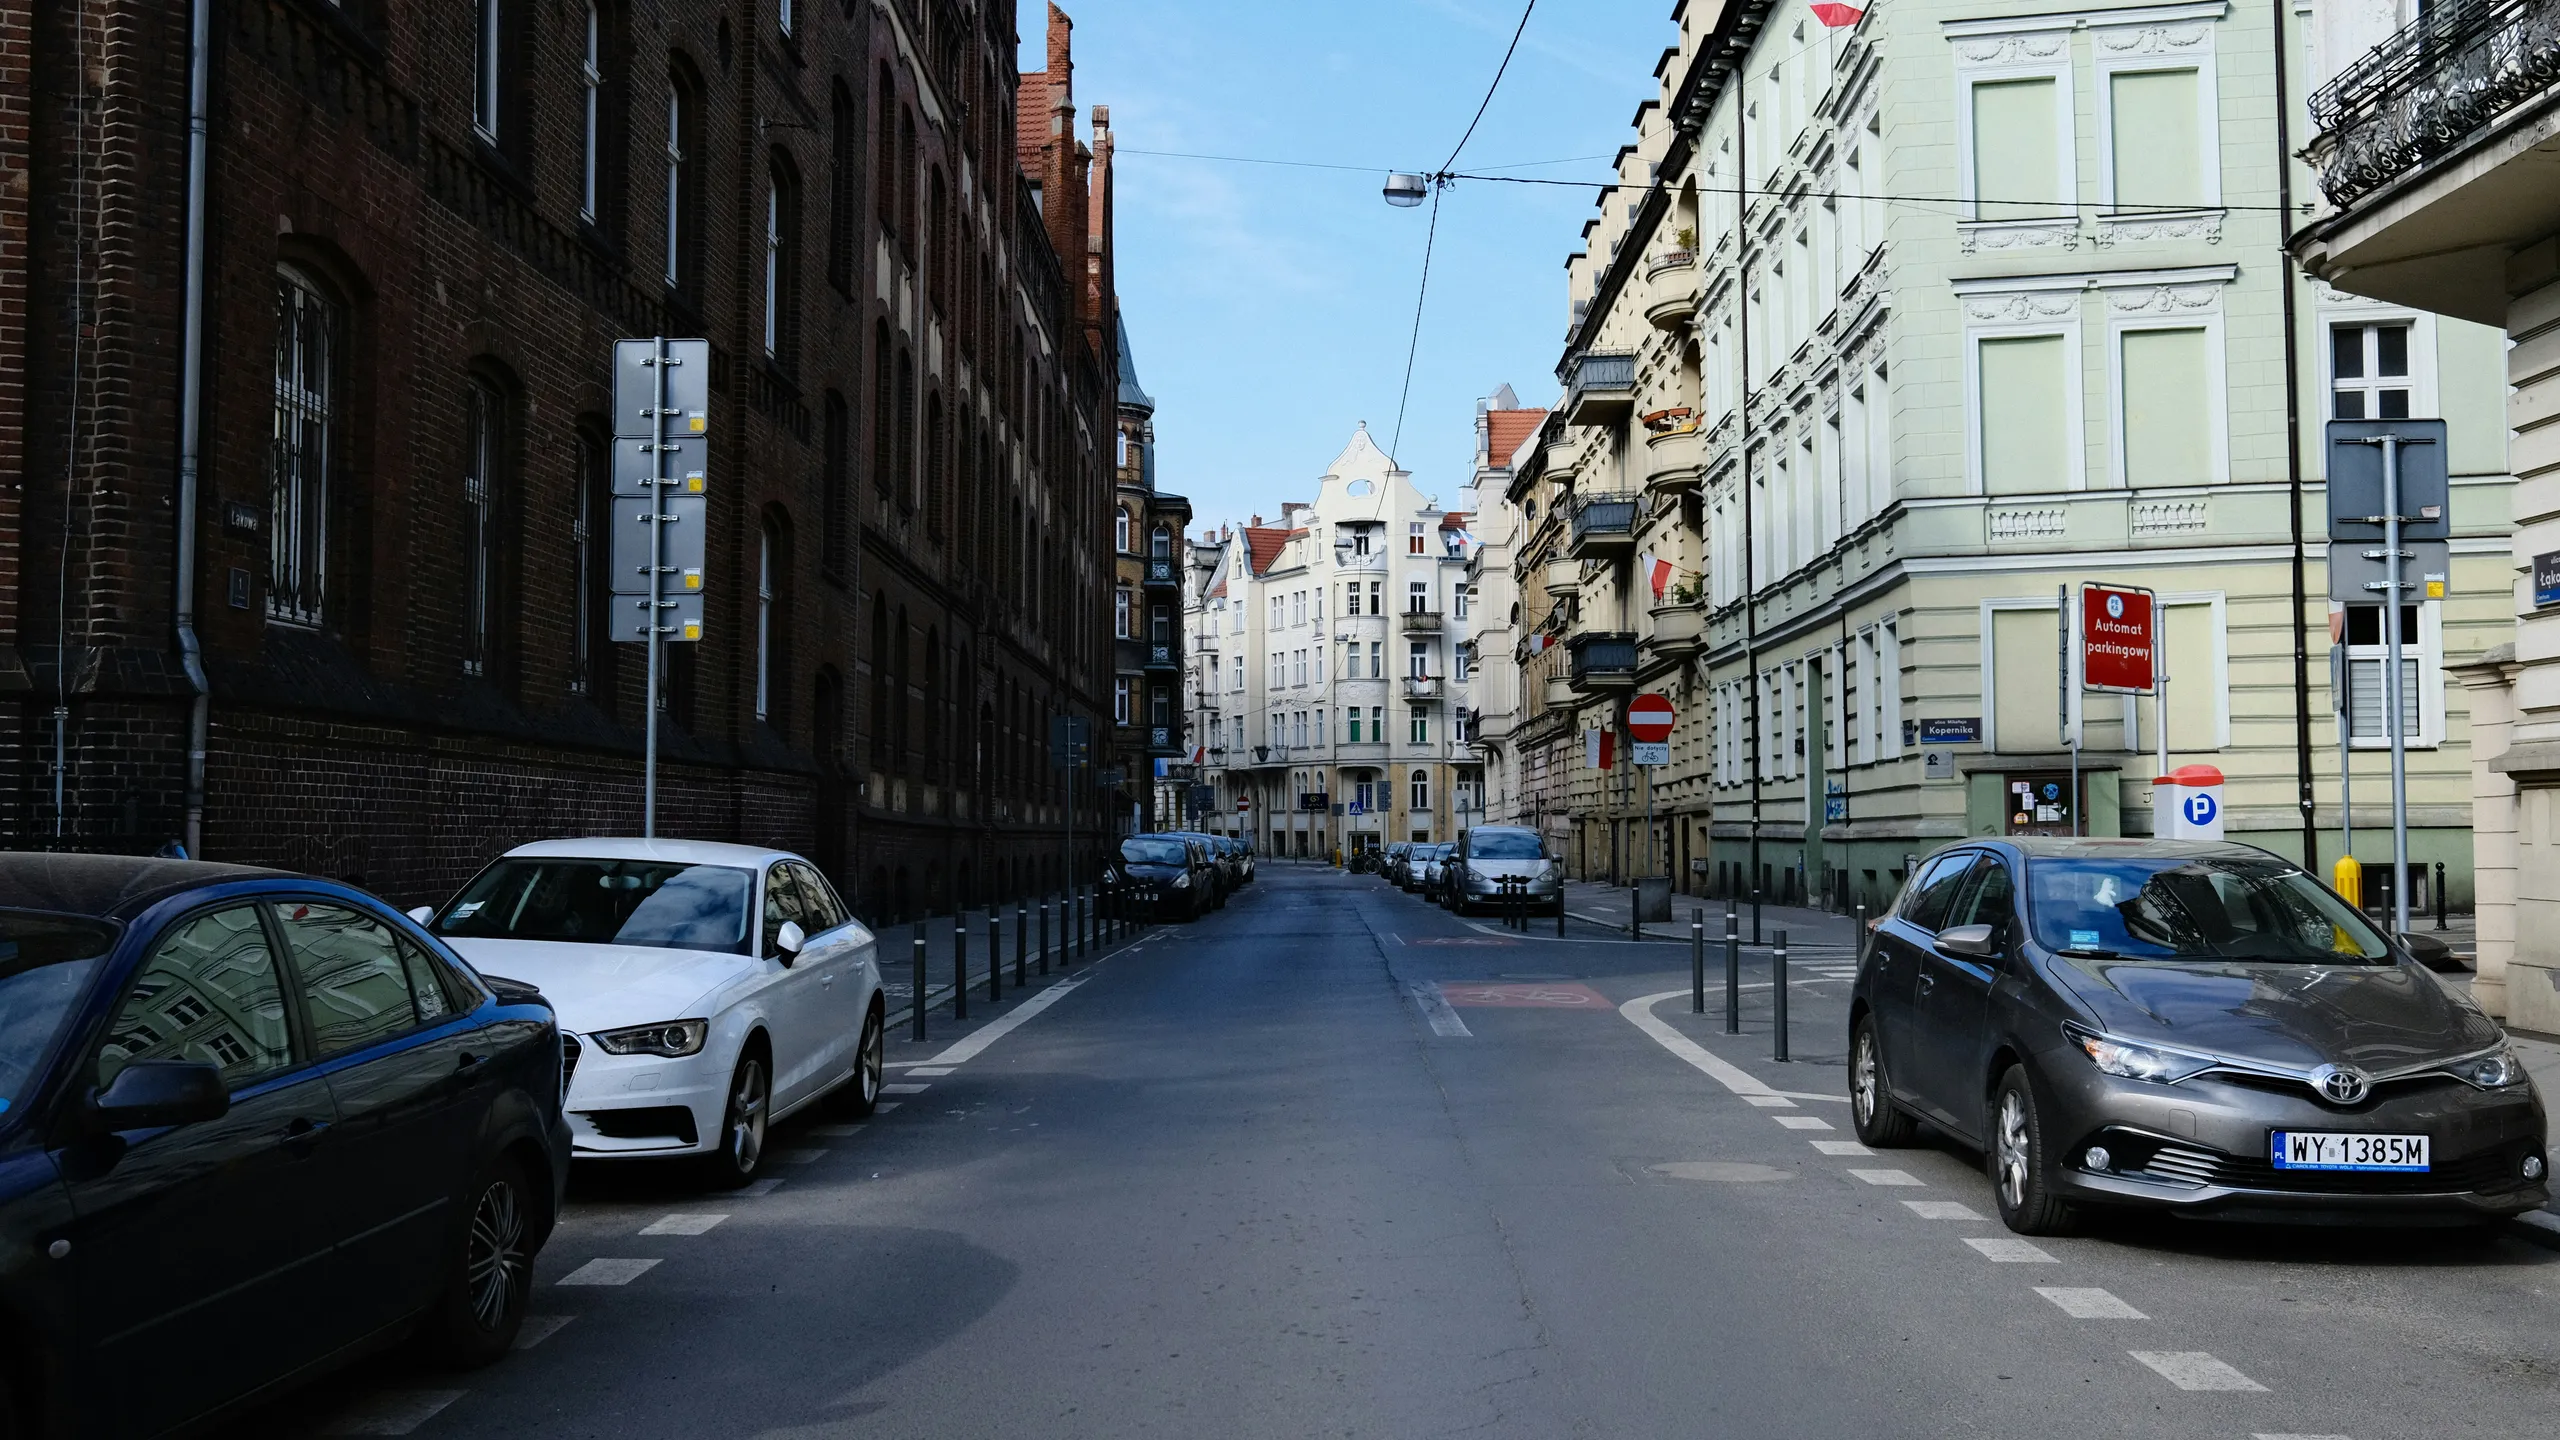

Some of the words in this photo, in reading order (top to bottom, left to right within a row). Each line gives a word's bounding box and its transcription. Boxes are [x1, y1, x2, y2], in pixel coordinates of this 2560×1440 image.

[2095, 618, 2142, 635] Automat
[2087, 641, 2149, 661] parkingowy
[1929, 725, 1974, 736] Kopernika
[2274, 1151, 2284, 1159] PL
[2292, 1136, 2326, 1162] WY
[2340, 1137, 2422, 1165] 1385M
